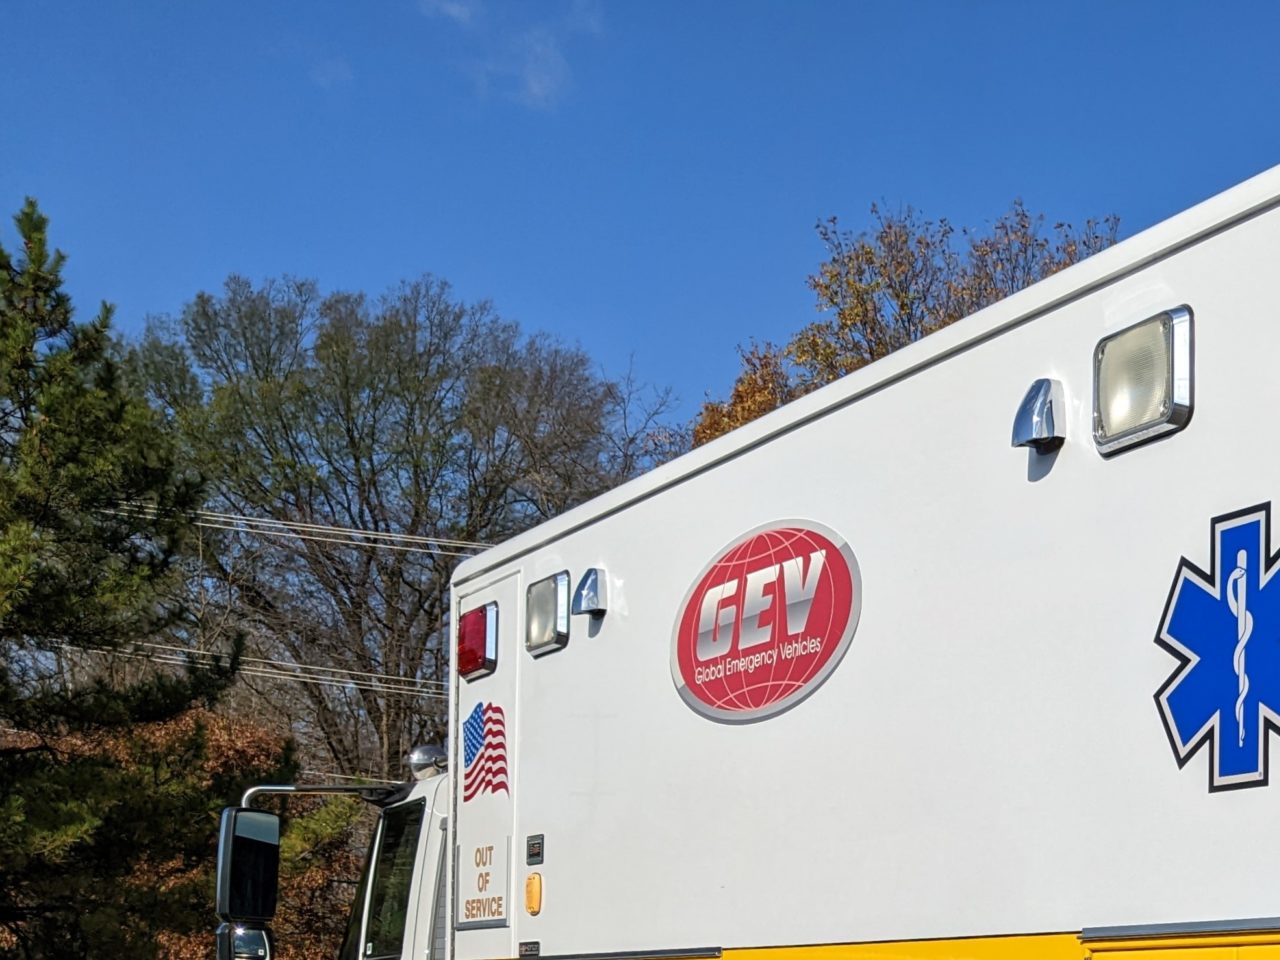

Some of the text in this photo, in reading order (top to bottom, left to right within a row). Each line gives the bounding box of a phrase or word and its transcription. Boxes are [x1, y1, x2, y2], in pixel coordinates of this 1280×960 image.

[696, 549, 826, 661] GEV
[695, 636, 821, 685] Global Emergency Vehicles
[474, 845, 494, 868] OUT
[477, 872, 490, 892] OF
[464, 896, 503, 919] SERVICE
